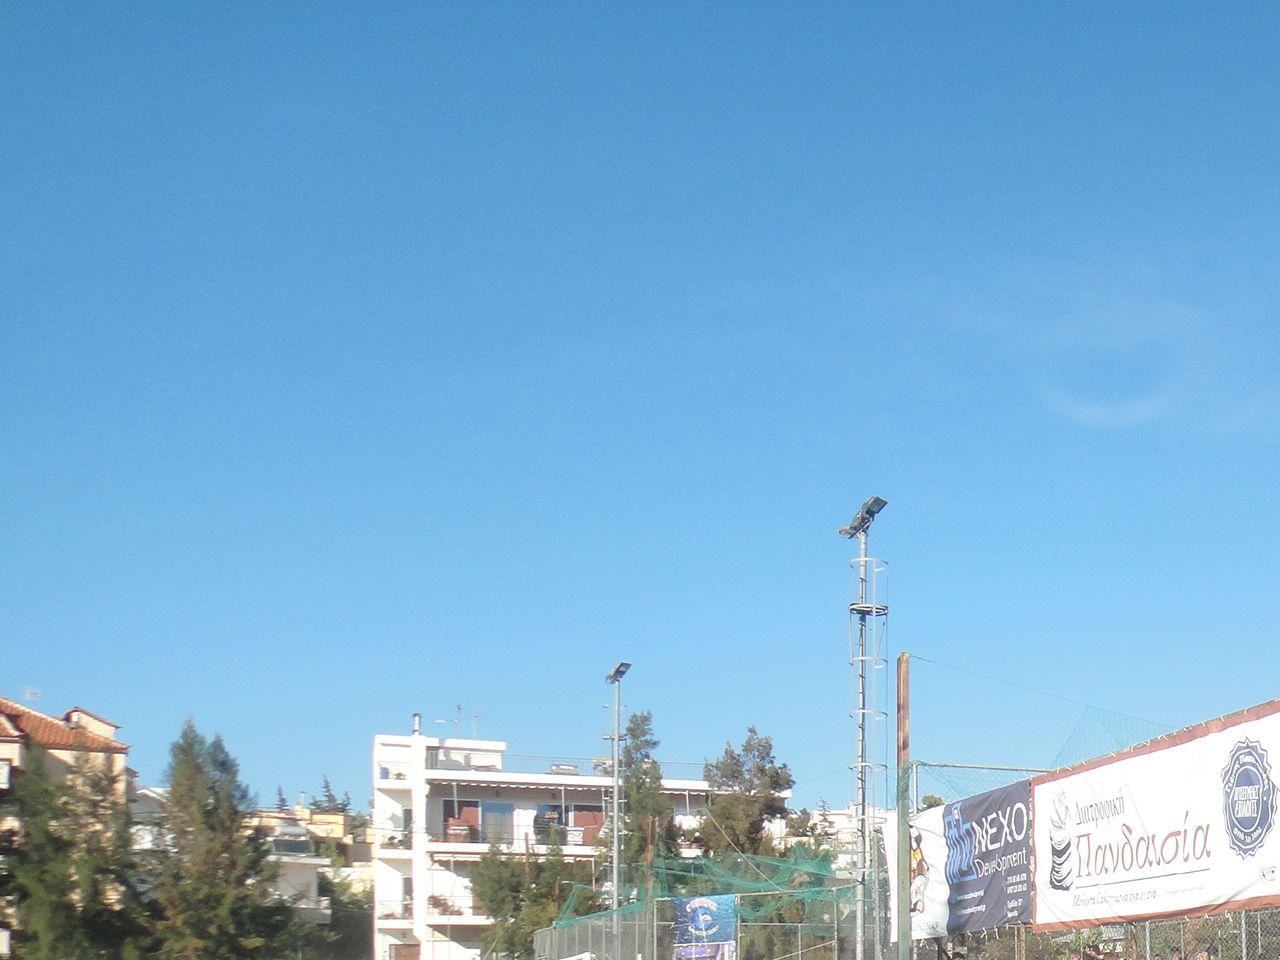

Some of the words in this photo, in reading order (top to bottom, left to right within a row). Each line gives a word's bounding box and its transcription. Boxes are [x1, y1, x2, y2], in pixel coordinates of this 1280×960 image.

[972, 802, 1027, 855] NEXO
[1075, 810, 1211, 878] Πανδαισία
[974, 847, 1027, 878] Development
